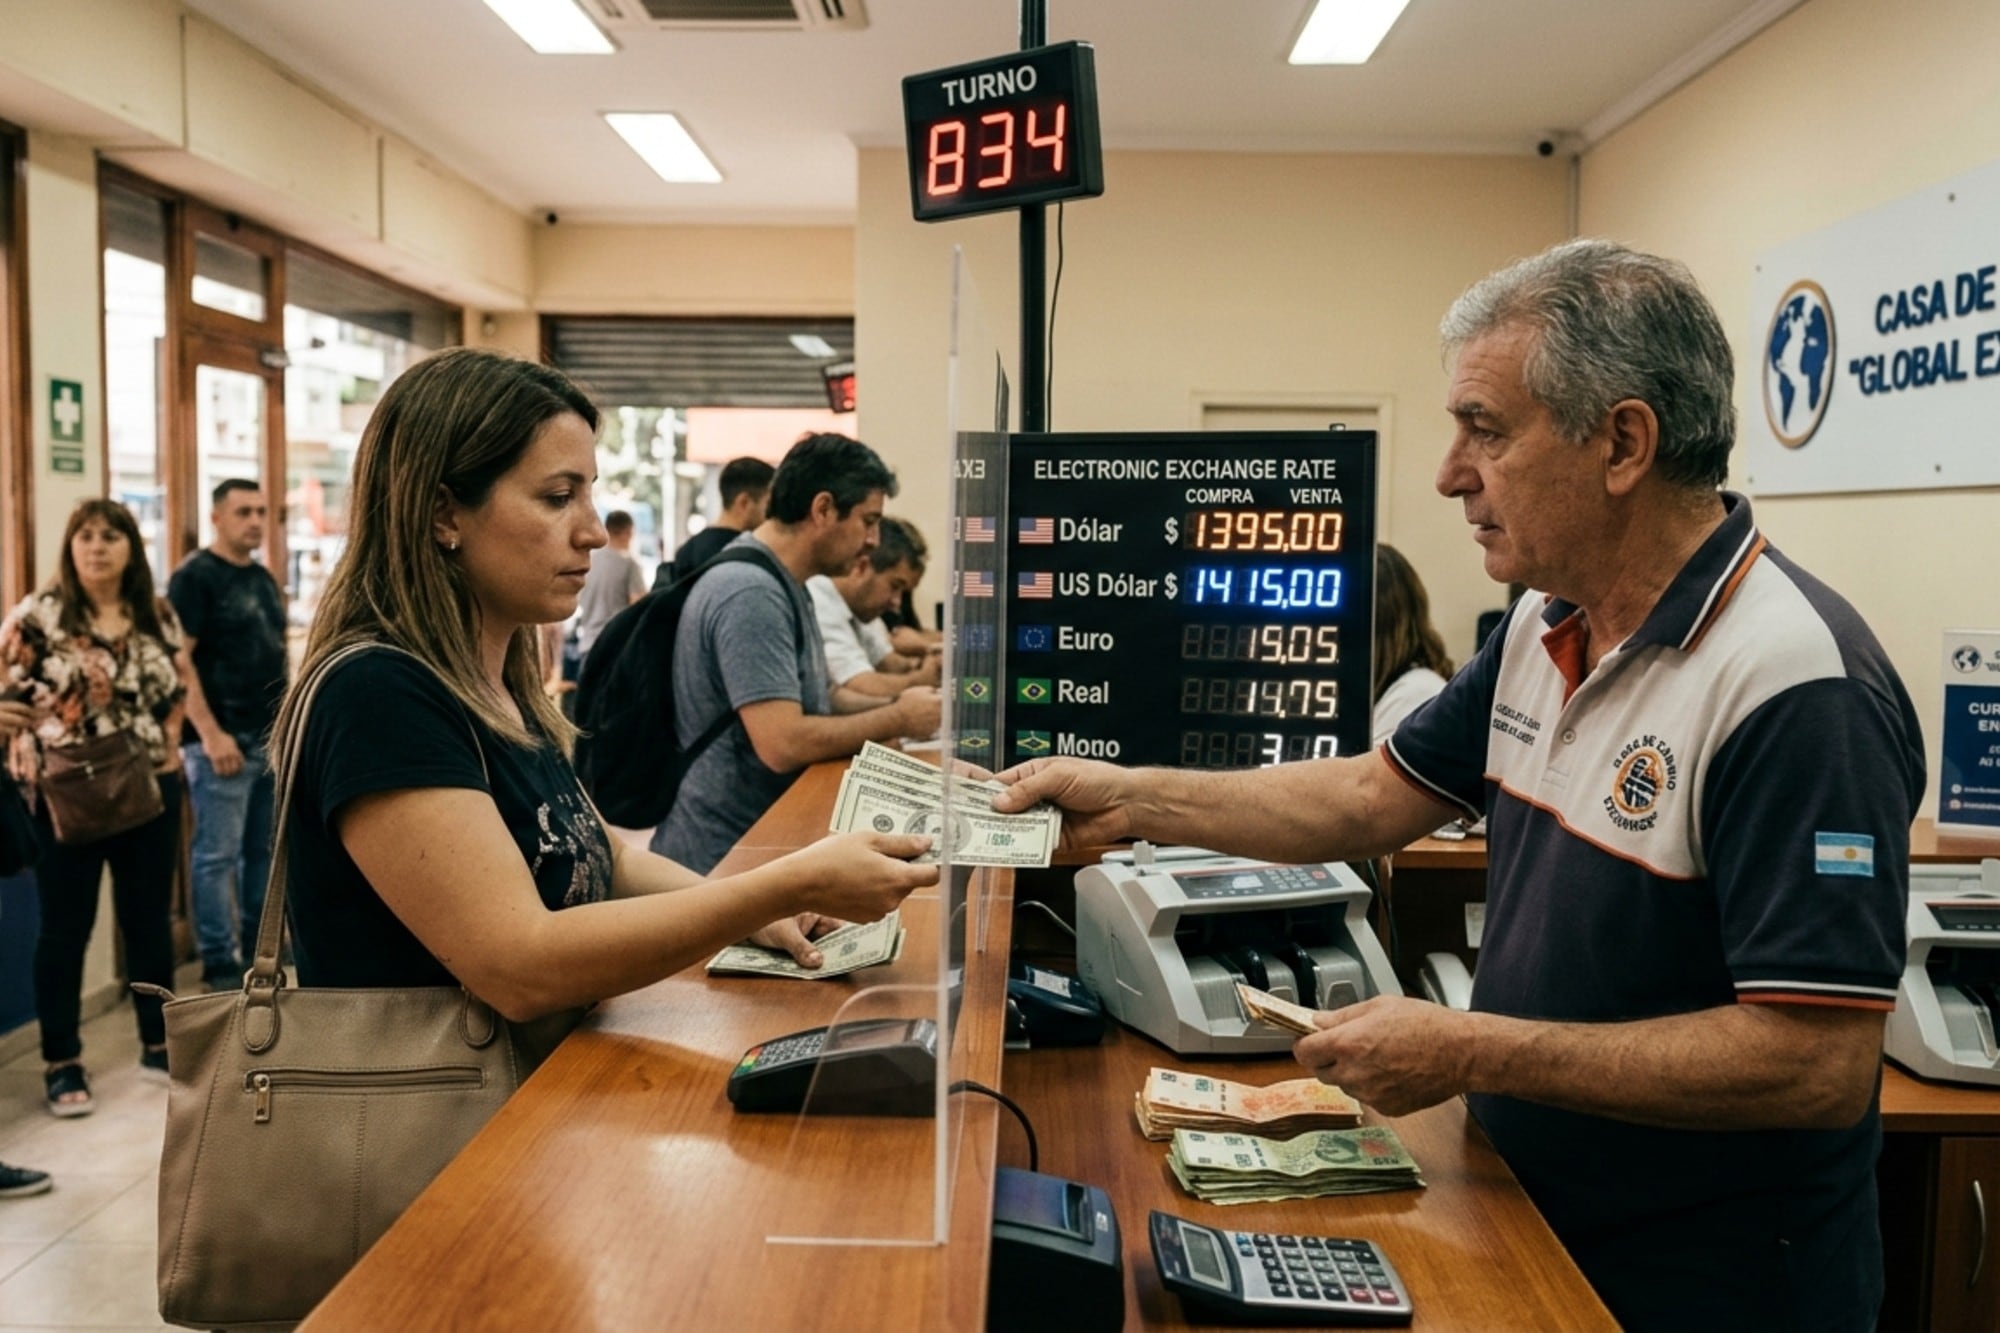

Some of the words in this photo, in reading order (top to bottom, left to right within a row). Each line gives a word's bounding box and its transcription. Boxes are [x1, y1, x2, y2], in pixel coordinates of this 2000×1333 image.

[941, 65, 1038, 107] TURNO
[927, 104, 1066, 196] 834
[1875, 279, 1948, 335] CASA
[1955, 264, 1997, 317] DE
[1849, 338, 1968, 396] "GLOBAL
[1034, 459, 1159, 480] ELECTRONIC
[1165, 459, 1277, 480] EXCHANGE
[1283, 459, 1336, 479] RATE
[1185, 488, 1254, 504] COMPRA
[1289, 488, 1343, 504] VENTA
[1060, 517, 1123, 543] Dólar
[1164, 517, 1179, 545] $
[1196, 512, 1343, 553] 1395,00
[1059, 572, 1090, 596] US
[1098, 572, 1158, 597] Dólar
[1164, 572, 1178, 600] $
[1195, 568, 1343, 609] 1415,00
[1059, 626, 1114, 651] Euro
[1058, 679, 1109, 704] Real
